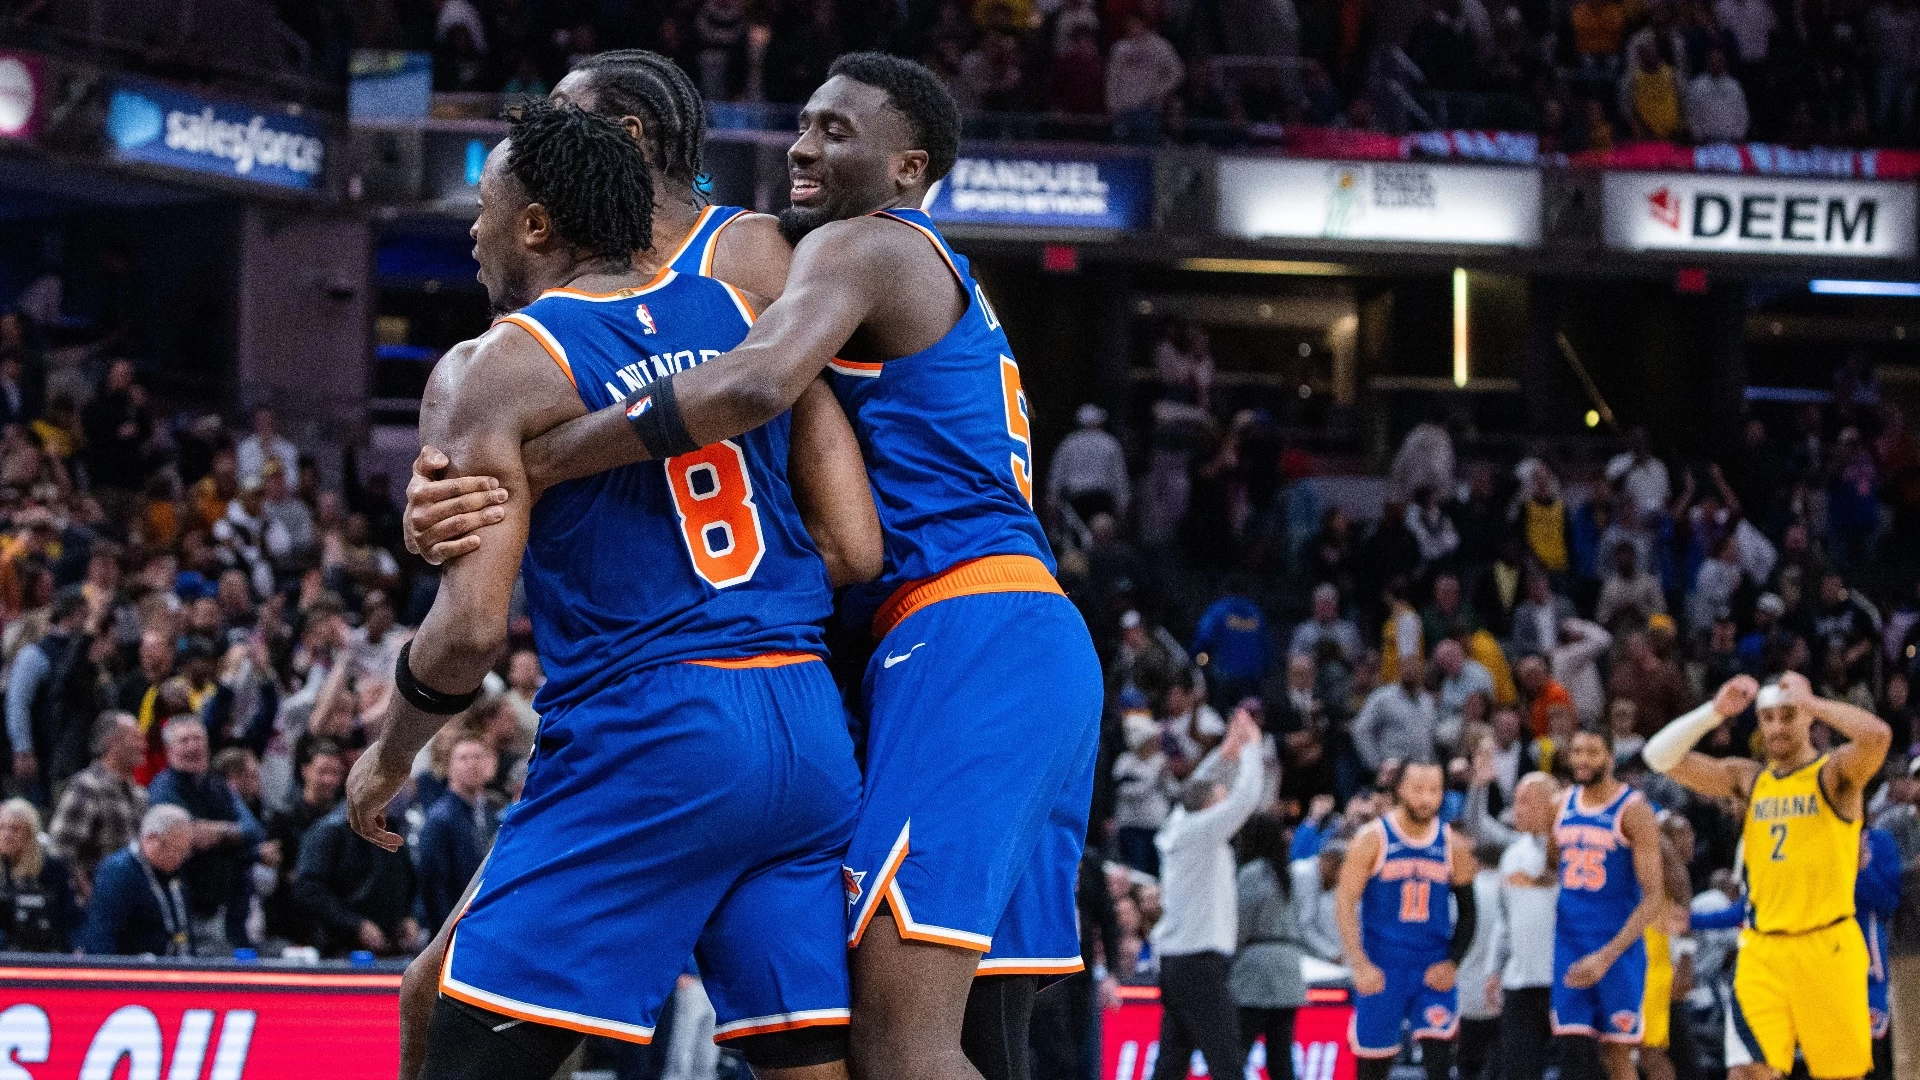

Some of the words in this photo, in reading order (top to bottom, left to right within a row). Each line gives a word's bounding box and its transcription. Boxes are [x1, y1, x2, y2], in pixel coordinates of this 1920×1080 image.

[165, 106, 324, 175] salesforce
[1692, 190, 1879, 244] DEEM
[664, 439, 766, 589] 8
[1769, 823, 1788, 861] 2
[1561, 847, 1607, 892] 25
[1399, 879, 1431, 922] 11
